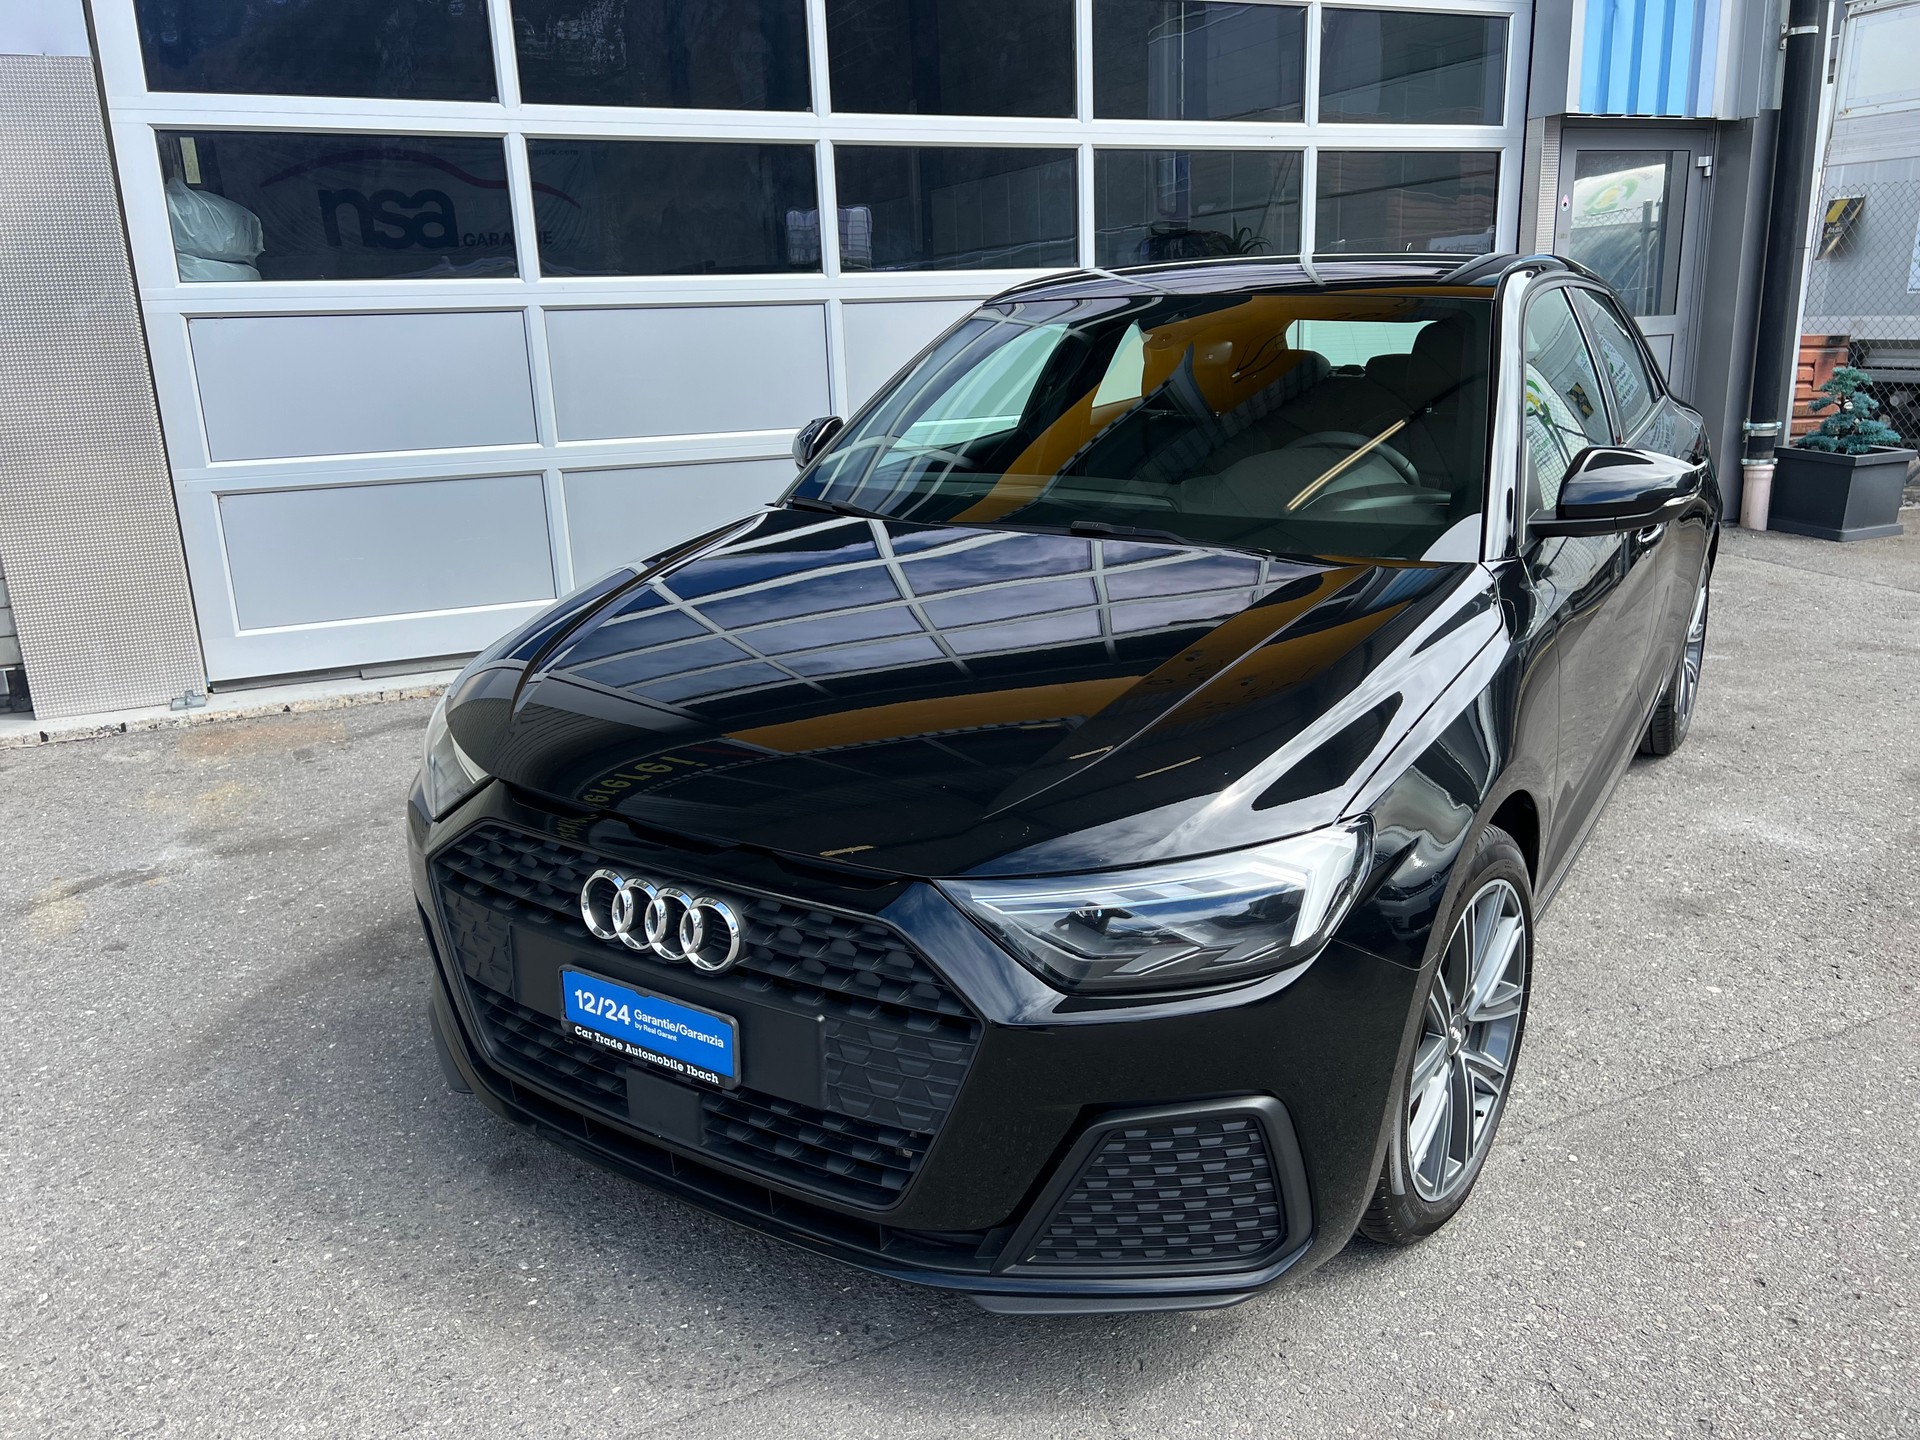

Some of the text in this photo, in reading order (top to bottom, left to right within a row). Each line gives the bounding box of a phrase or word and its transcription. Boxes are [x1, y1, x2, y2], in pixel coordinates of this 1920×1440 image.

[318, 188, 553, 249] nsa GARAIE
[574, 988, 631, 1026] 12/24
[633, 1008, 725, 1049] Garantie/Garanzia
[634, 1021, 678, 1042] by Real Garant
[574, 1025, 720, 1085] Car Trade Automobile Ibach
